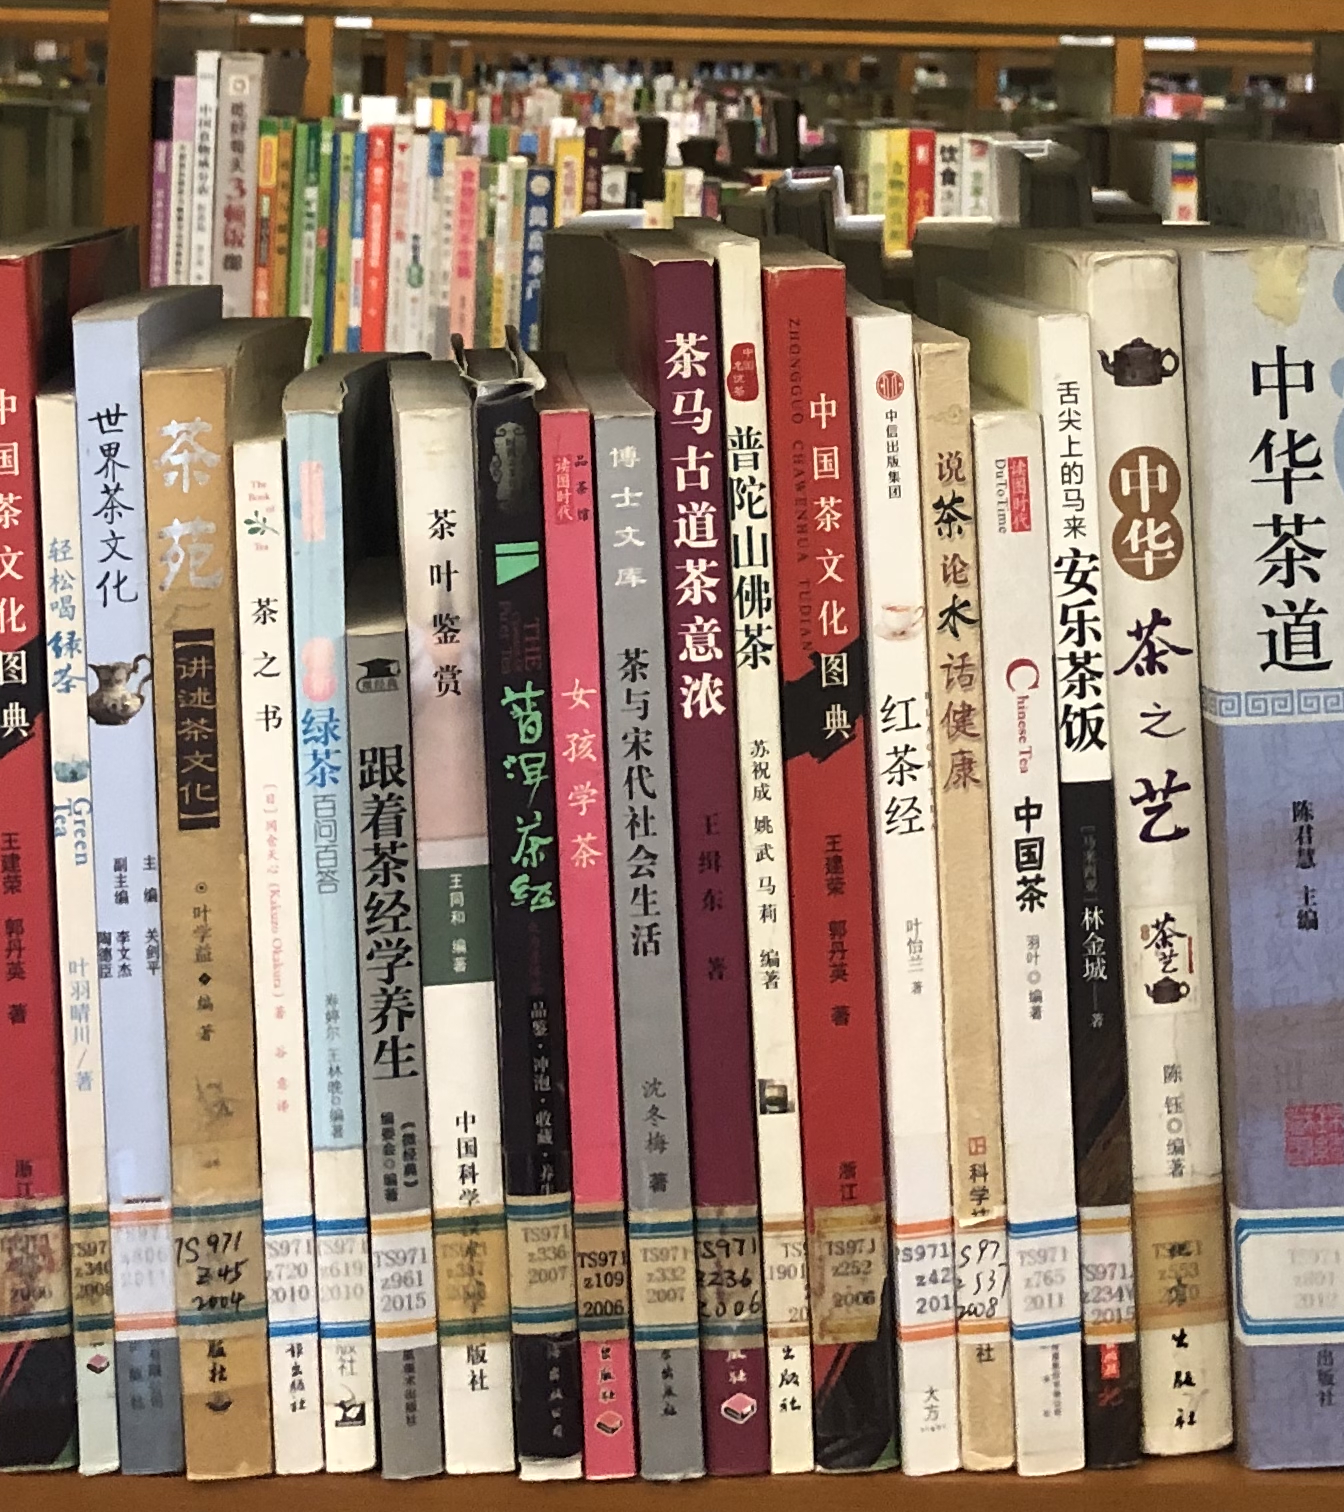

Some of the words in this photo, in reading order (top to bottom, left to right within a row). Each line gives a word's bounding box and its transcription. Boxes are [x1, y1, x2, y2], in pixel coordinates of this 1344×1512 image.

[787, 317, 805, 426] ZHONGGUO
[885, 408, 902, 499] 中信出版集团
[88, 403, 139, 607] 世界茶文化
[157, 419, 224, 592] 茶苑
[608, 445, 650, 589] 博士文库
[664, 331, 727, 721] 茶马古道茶意浓
[727, 425, 775, 670] 普陀山佛茶
[791, 439, 809, 564] CHAWENHUA
[808, 392, 852, 740] 中国茶文化图典
[993, 458, 1008, 535] DuToTime
[1248, 344, 1335, 674] 中华茶道
[250, 597, 283, 732] 茶之书
[426, 507, 463, 698] 茶叶鉴赏
[932, 450, 982, 792] 说茶论水话健康
[1052, 547, 1108, 754] 安乐茶饭
[1112, 450, 1196, 844] 中华茶之艺
[70, 796, 91, 866] Green
[500, 681, 556, 913] 普洱茶经
[561, 677, 604, 869] 女孩学茶
[617, 647, 664, 958] 茶与宋代社会生活
[878, 692, 926, 837] 红茶经
[357, 742, 420, 1082] 跟着茶经学养生
[1013, 796, 1049, 913] 中国茶
[1080, 905, 1108, 982] 林金城
[577, 1250, 628, 1269] TS971
[582, 1271, 625, 1290] z109
[582, 1300, 626, 1319] 2006
